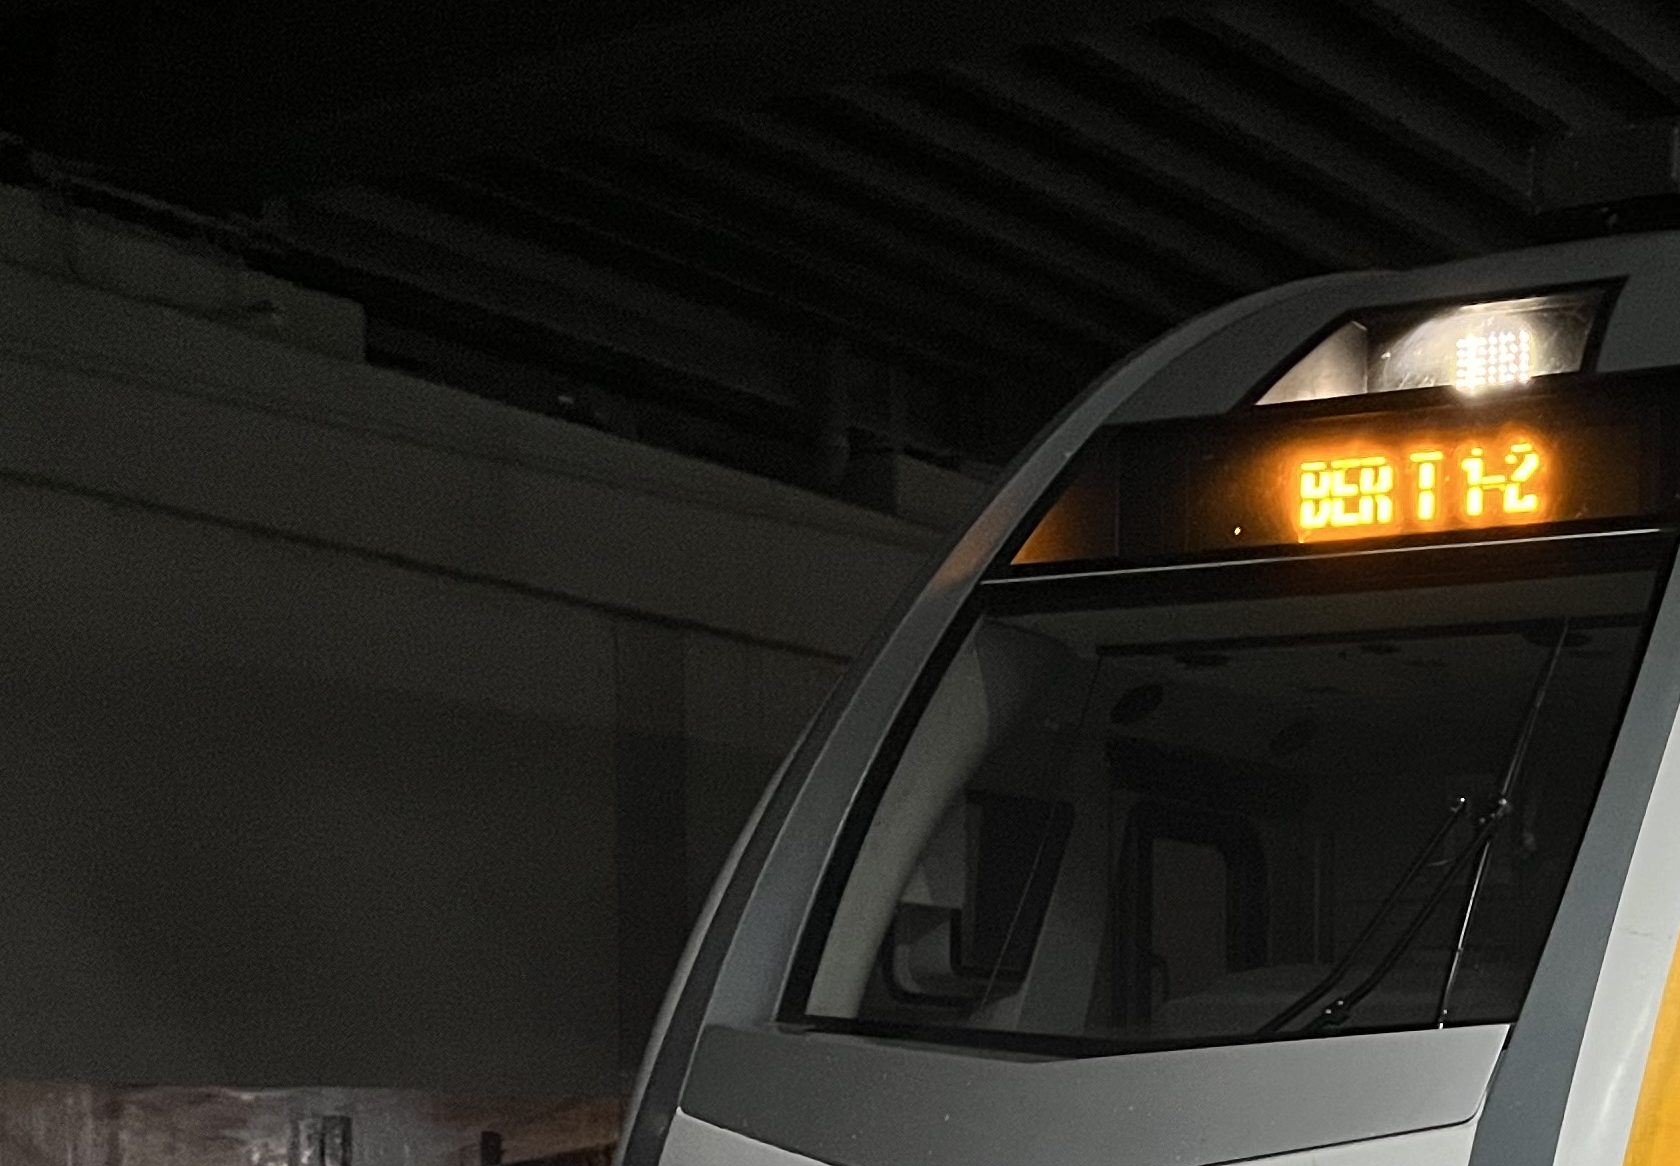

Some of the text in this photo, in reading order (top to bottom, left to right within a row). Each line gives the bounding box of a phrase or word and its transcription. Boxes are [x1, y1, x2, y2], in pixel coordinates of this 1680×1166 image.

[1300, 443, 1540, 528] BER T 1-2
